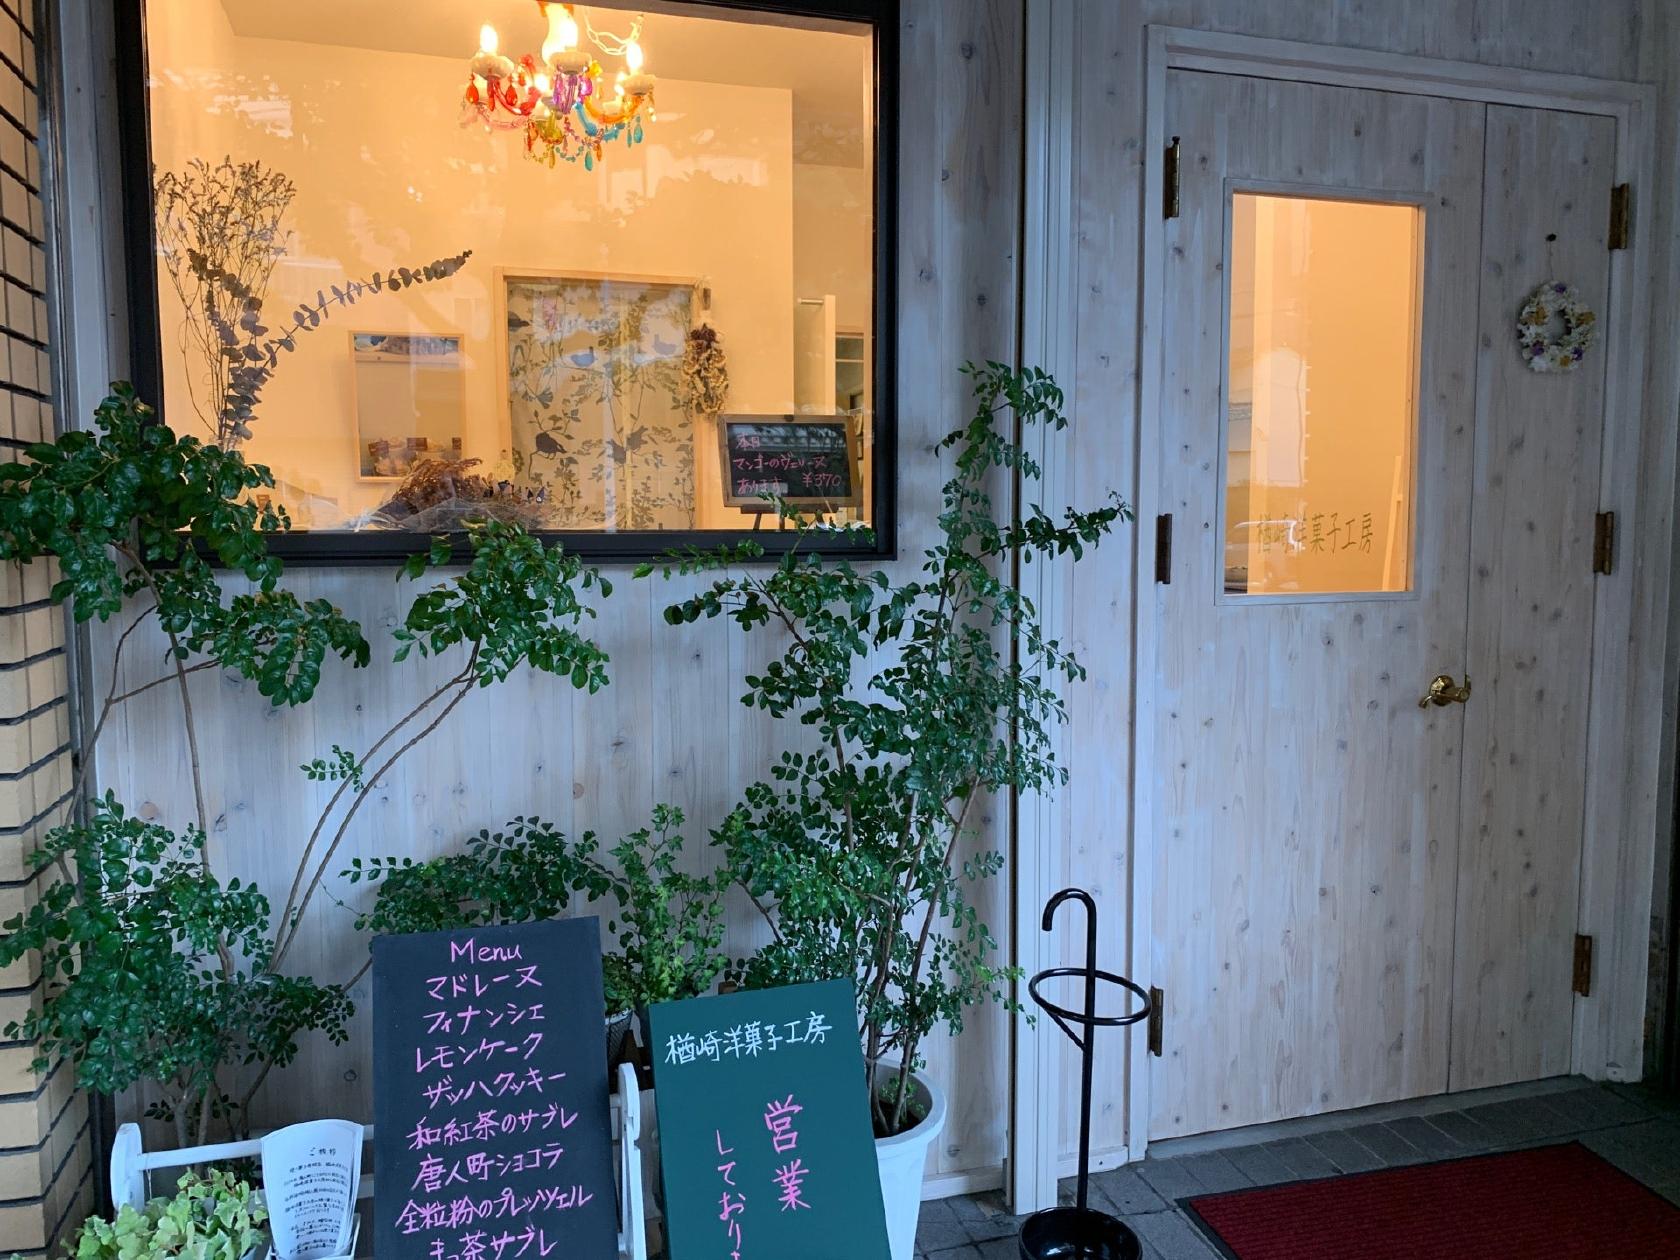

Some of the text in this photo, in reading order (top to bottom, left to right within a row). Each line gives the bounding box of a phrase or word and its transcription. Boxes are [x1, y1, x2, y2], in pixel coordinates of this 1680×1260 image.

[450, 937, 523, 964] Menu
[425, 965, 543, 1000] マドレーヌ
[423, 1003, 545, 1035] フィナンシェ
[664, 1011, 833, 1065] 楢崎洋菓子工房
[416, 1032, 543, 1073] レモンケーク
[422, 1067, 567, 1109] ザッハクッキー
[406, 1102, 579, 1151] 和紅茶のサブレ
[411, 1143, 564, 1194] 唐人町ショコラ
[764, 1094, 812, 1212] 営業
[395, 1186, 594, 1234] 全粒粉のプレッツェル
